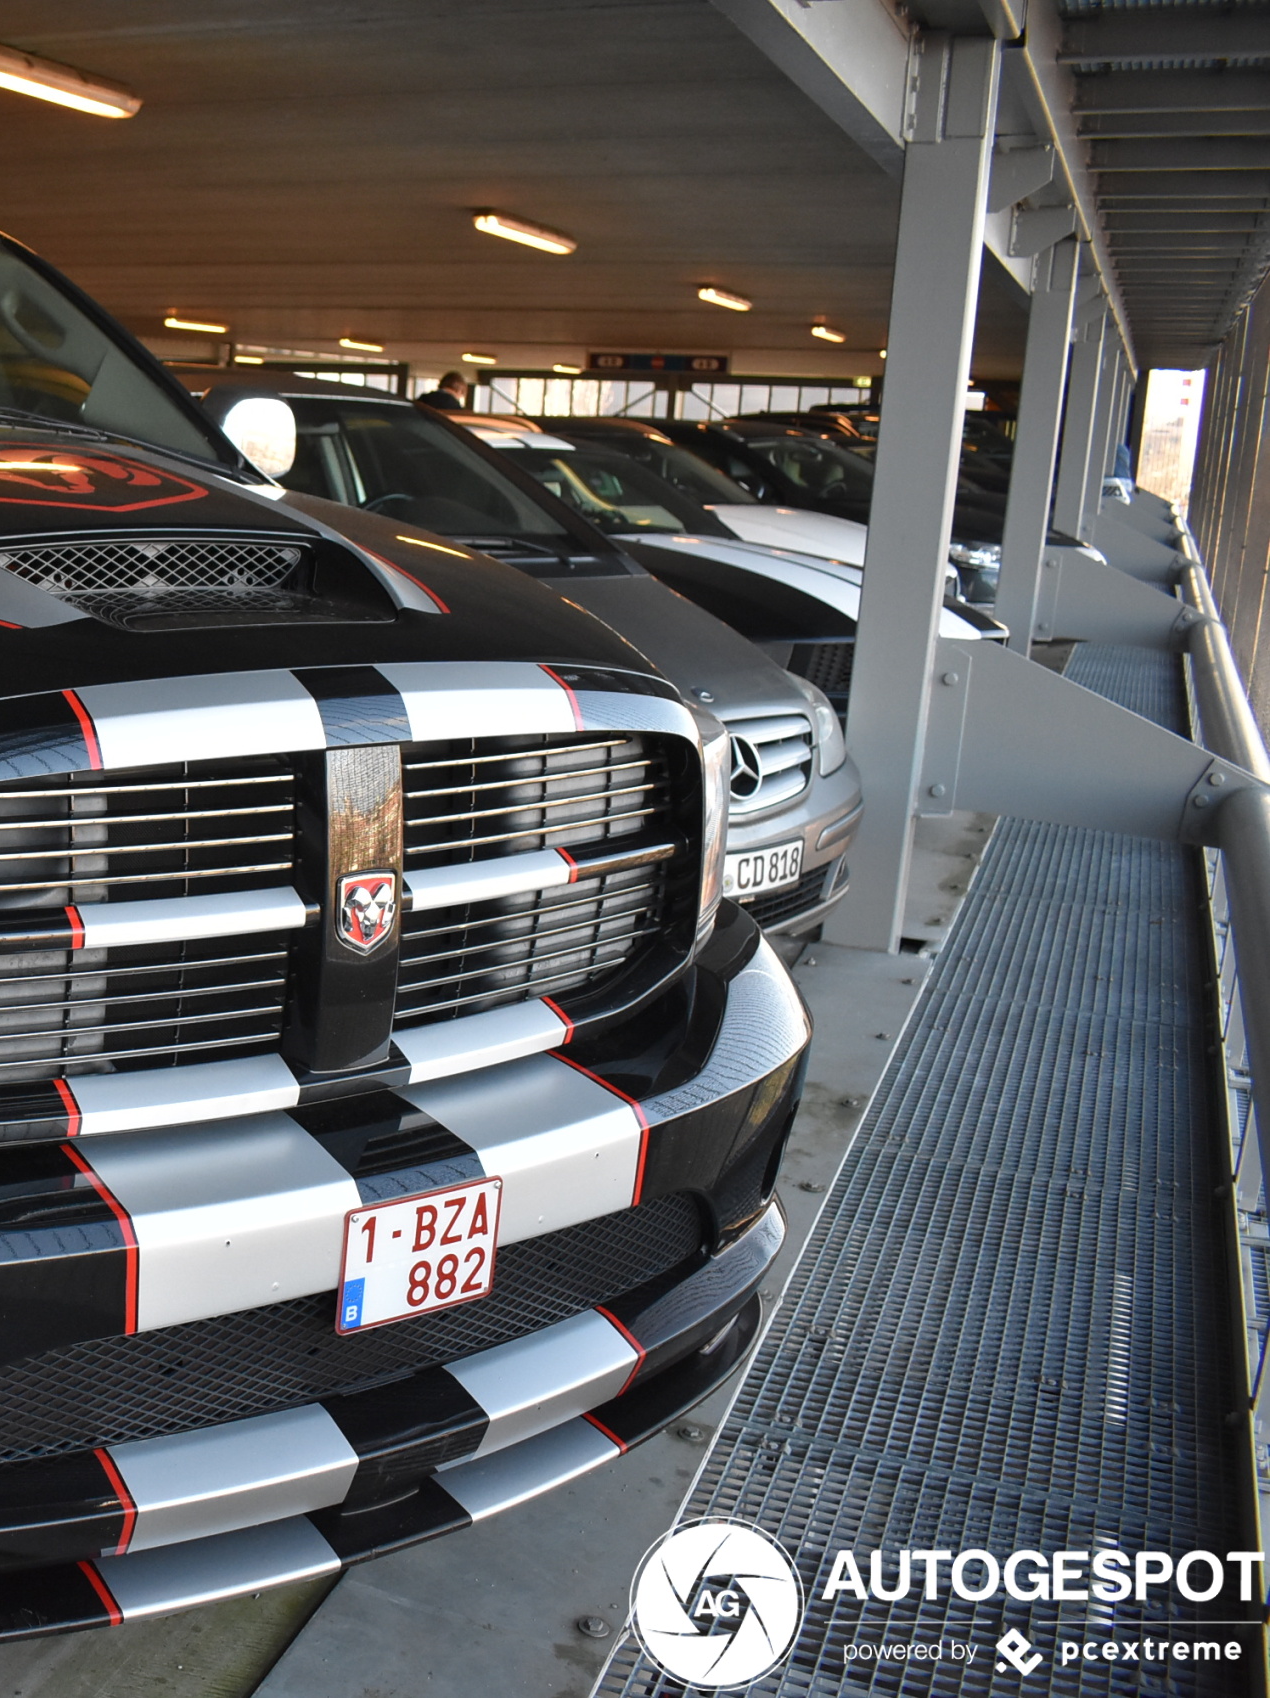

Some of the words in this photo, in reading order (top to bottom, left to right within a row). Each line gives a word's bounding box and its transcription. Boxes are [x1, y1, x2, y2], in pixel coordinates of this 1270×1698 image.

[737, 855, 765, 890] CD
[768, 846, 800, 883] 818
[406, 1246, 486, 1307] 882
[345, 1305, 358, 1322] B
